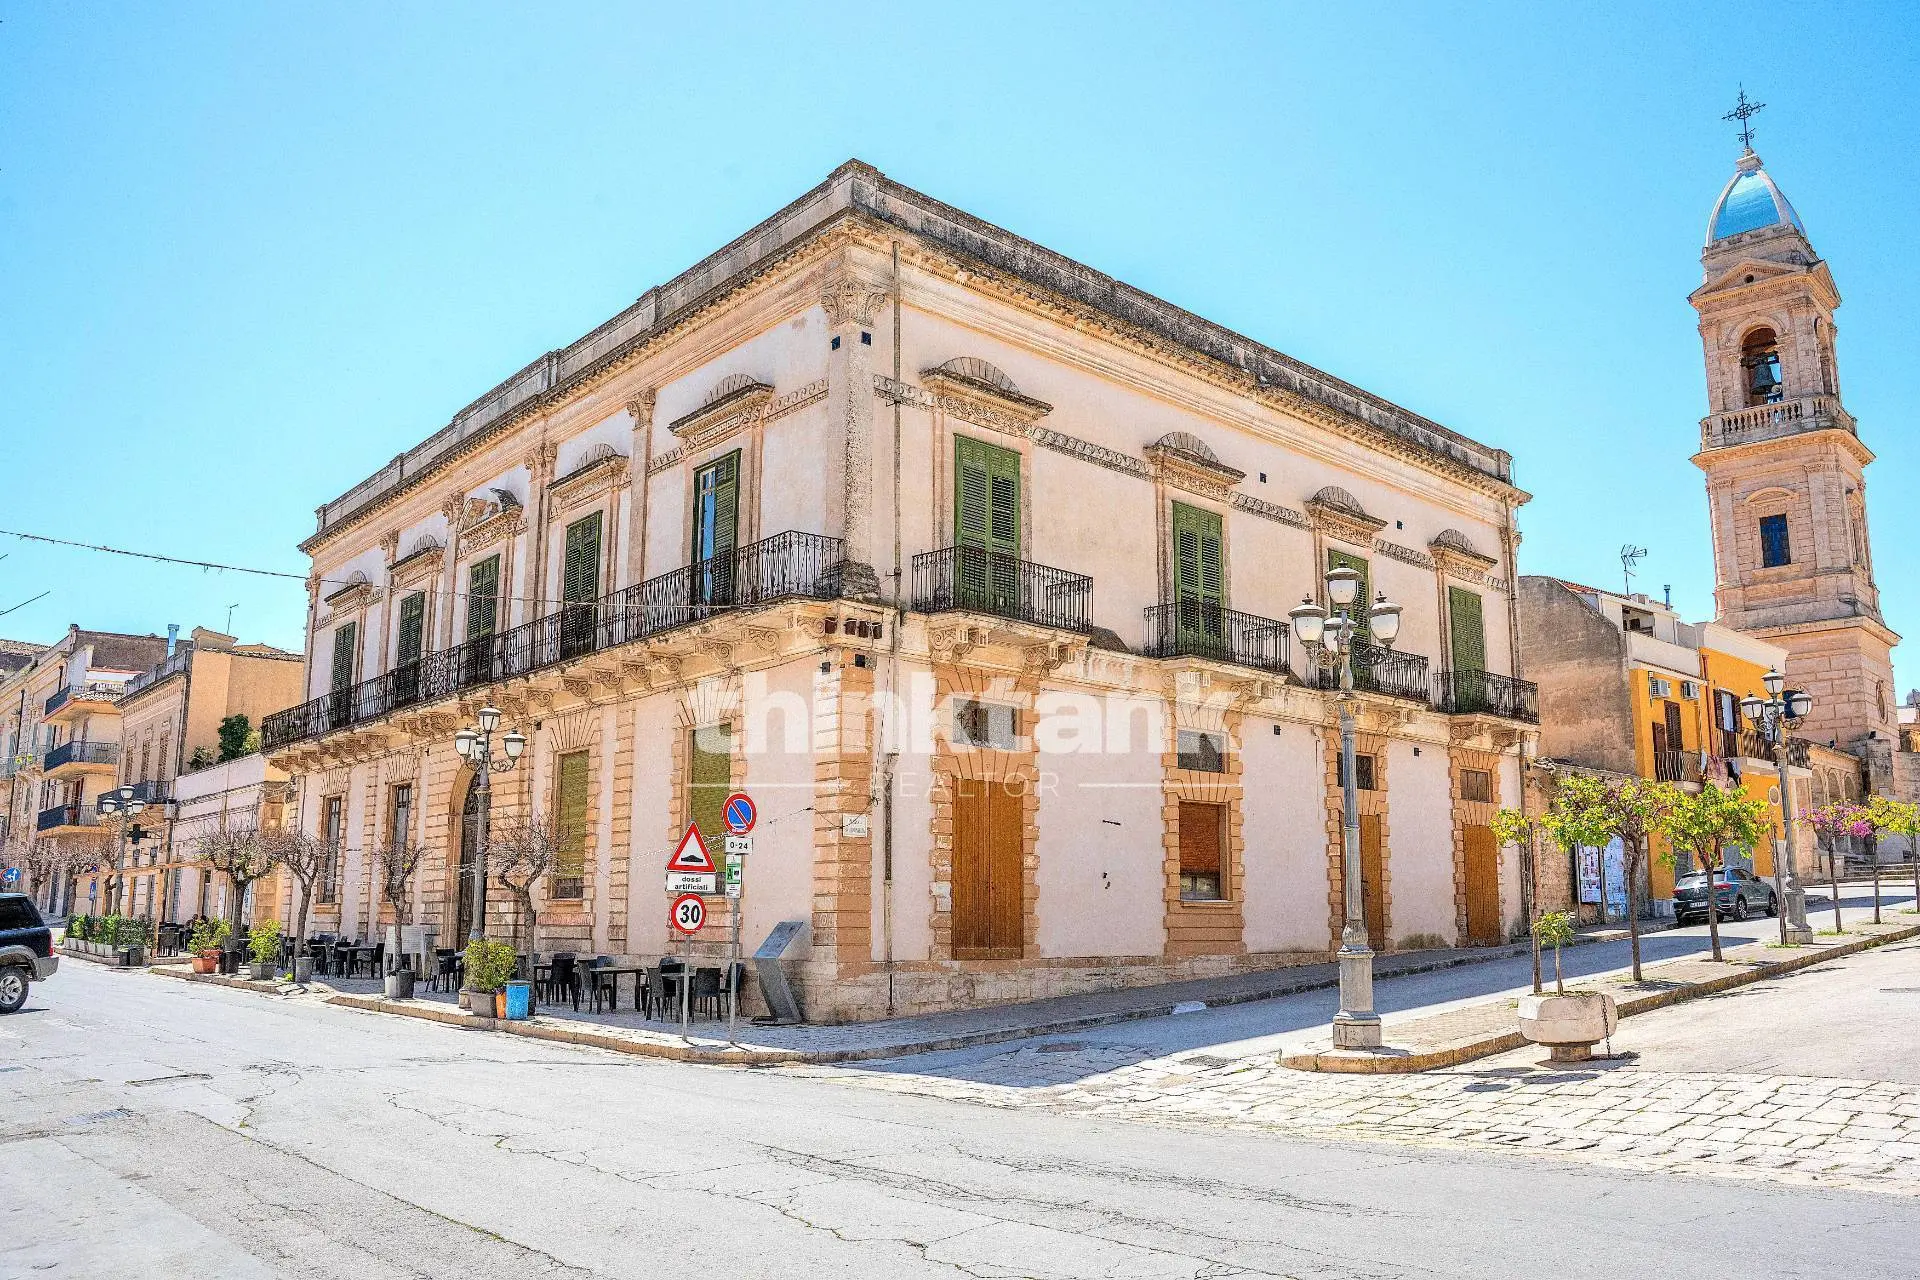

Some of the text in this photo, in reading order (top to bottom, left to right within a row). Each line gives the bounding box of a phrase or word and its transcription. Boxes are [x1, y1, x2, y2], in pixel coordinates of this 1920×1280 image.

[729, 841, 748, 850] 0-24
[674, 883, 708, 891] artificiali
[680, 904, 700, 924] 30
